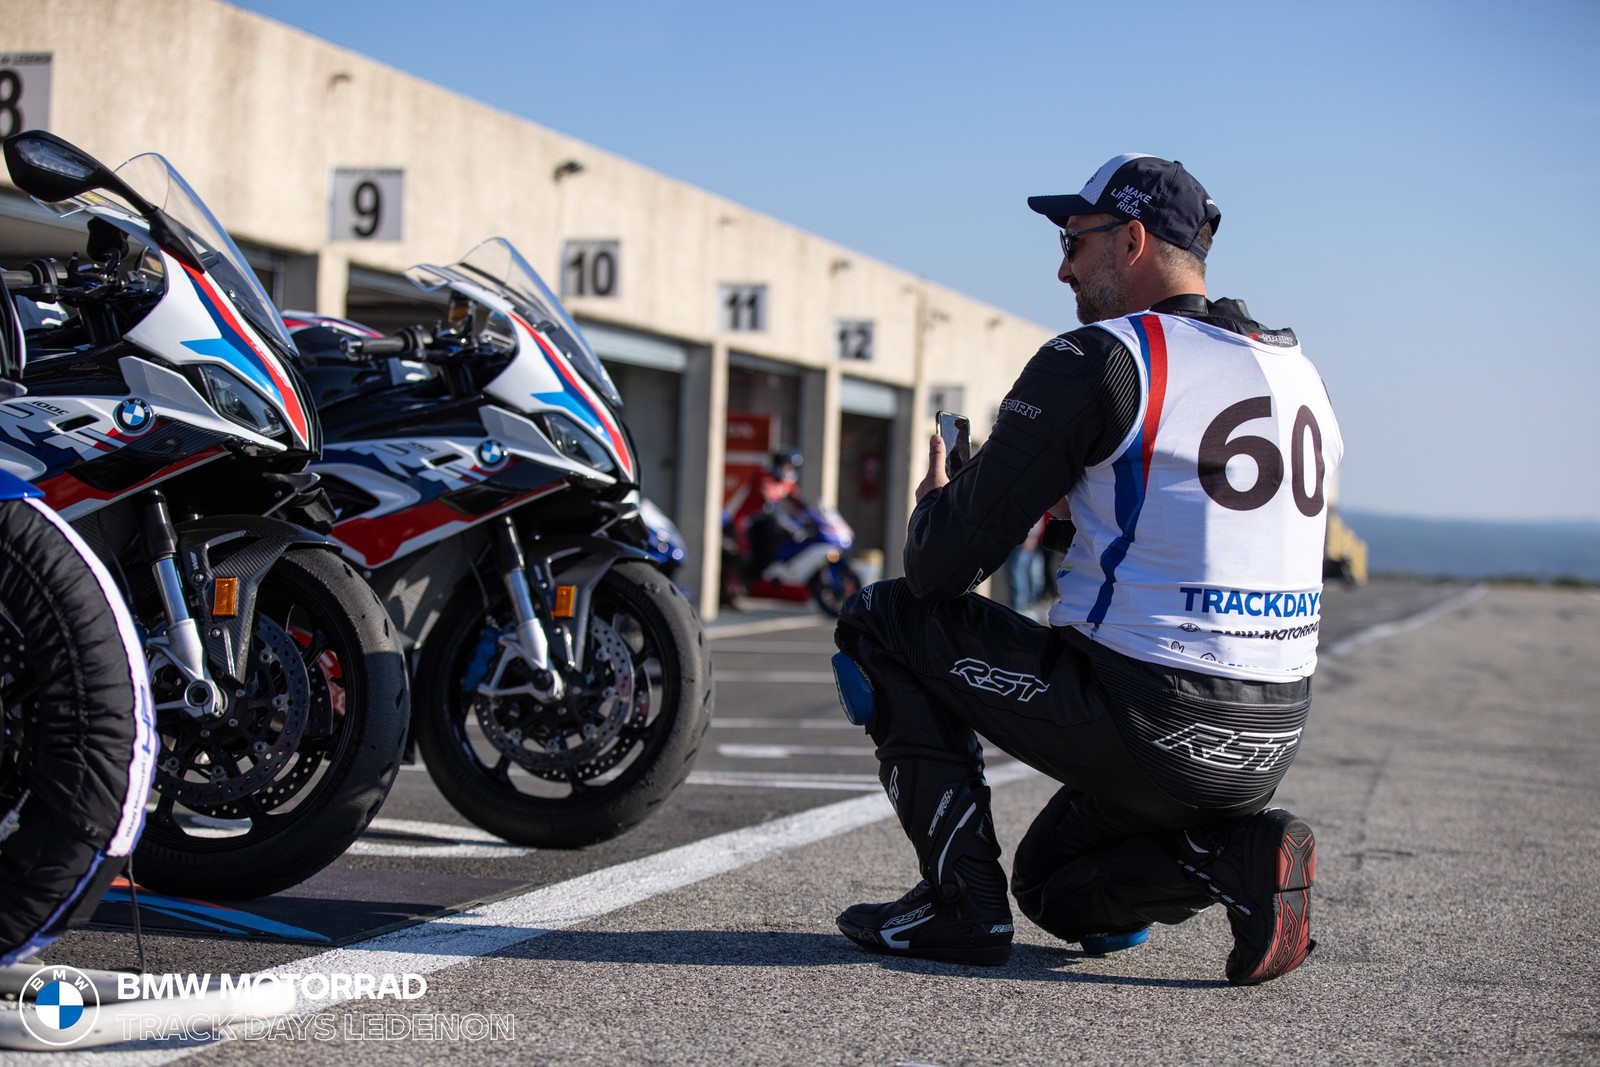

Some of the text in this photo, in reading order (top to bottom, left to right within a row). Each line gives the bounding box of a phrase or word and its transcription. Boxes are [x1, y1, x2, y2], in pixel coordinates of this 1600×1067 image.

[0, 70, 24, 139] 8
[351, 181, 382, 240] 9
[1110, 187, 1140, 208] LIFE A
[1116, 200, 1141, 219] RIDE.
[1122, 184, 1152, 204] MAKE
[567, 251, 615, 297] 10
[726, 292, 759, 331] 11
[839, 328, 869, 361] 12
[1197, 395, 1326, 518] 60
[949, 657, 1051, 702] RST
[1151, 722, 1303, 771] RST
[882, 902, 932, 929] RST
